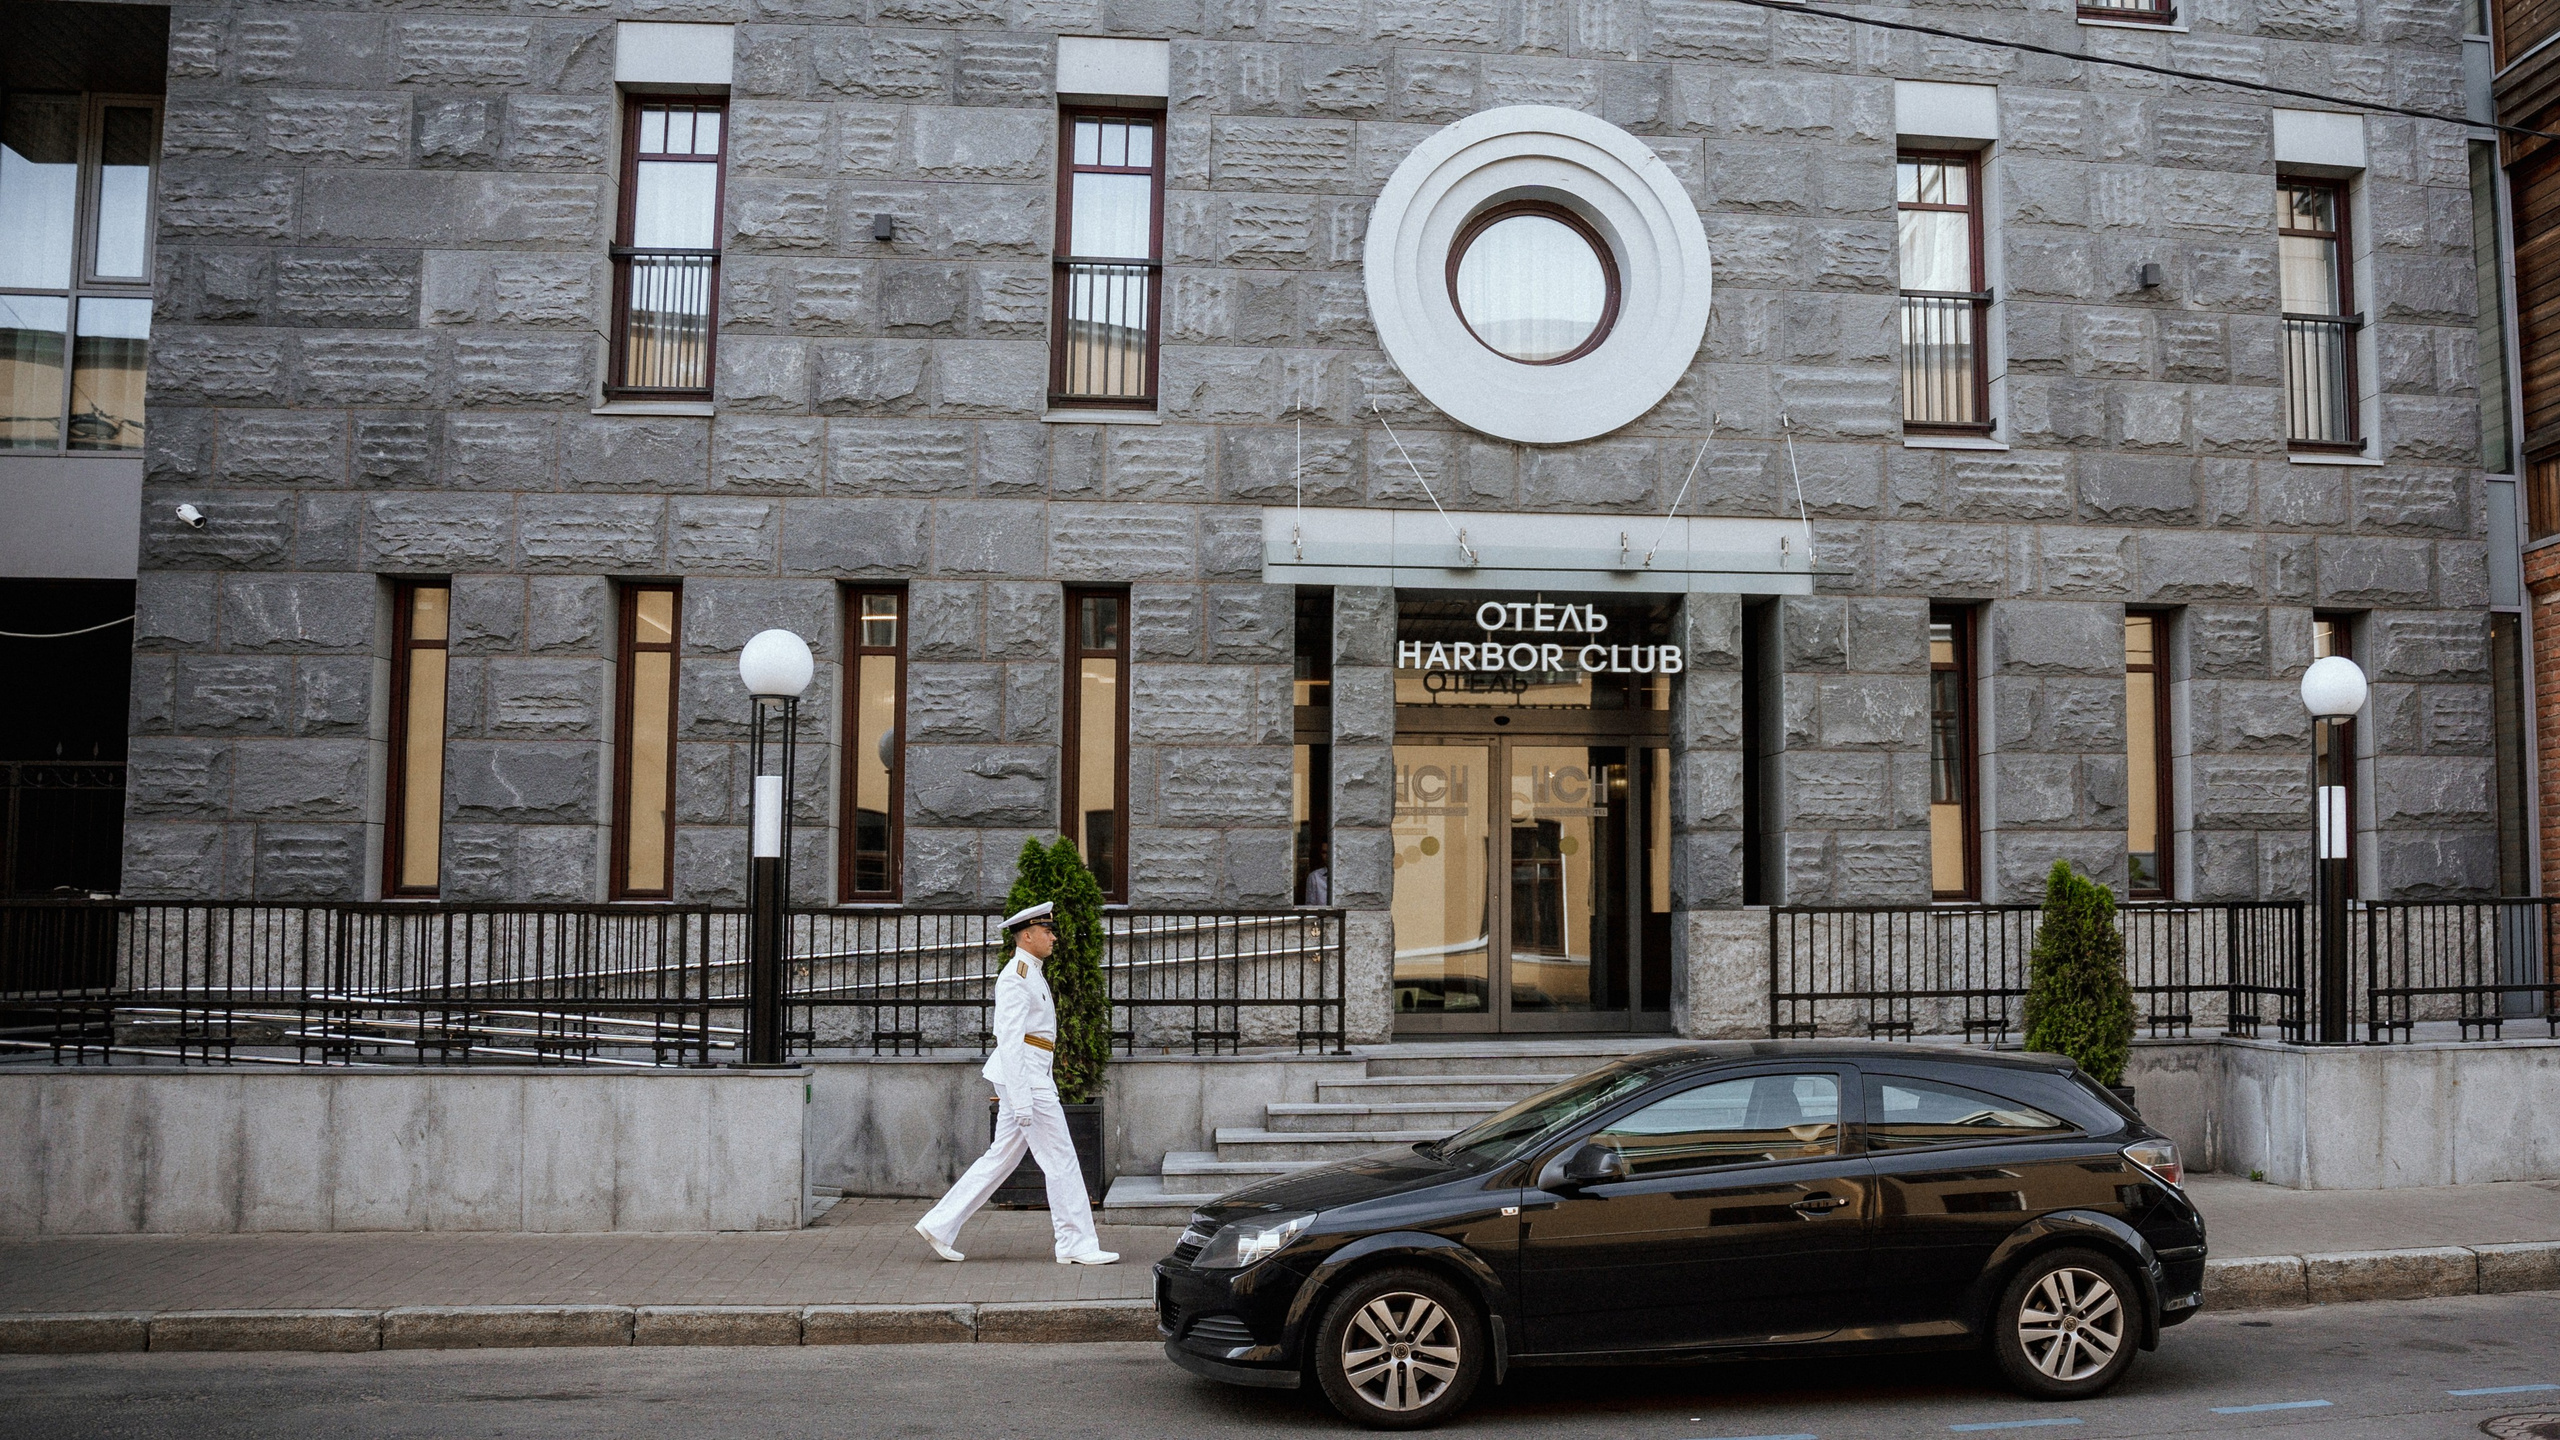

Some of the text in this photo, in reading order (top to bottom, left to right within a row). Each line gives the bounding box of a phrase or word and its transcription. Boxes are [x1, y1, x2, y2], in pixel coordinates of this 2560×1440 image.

[1476, 601, 1608, 632] ОТЕЛЬ
[1398, 640, 1683, 674] HARBOR CLUB
